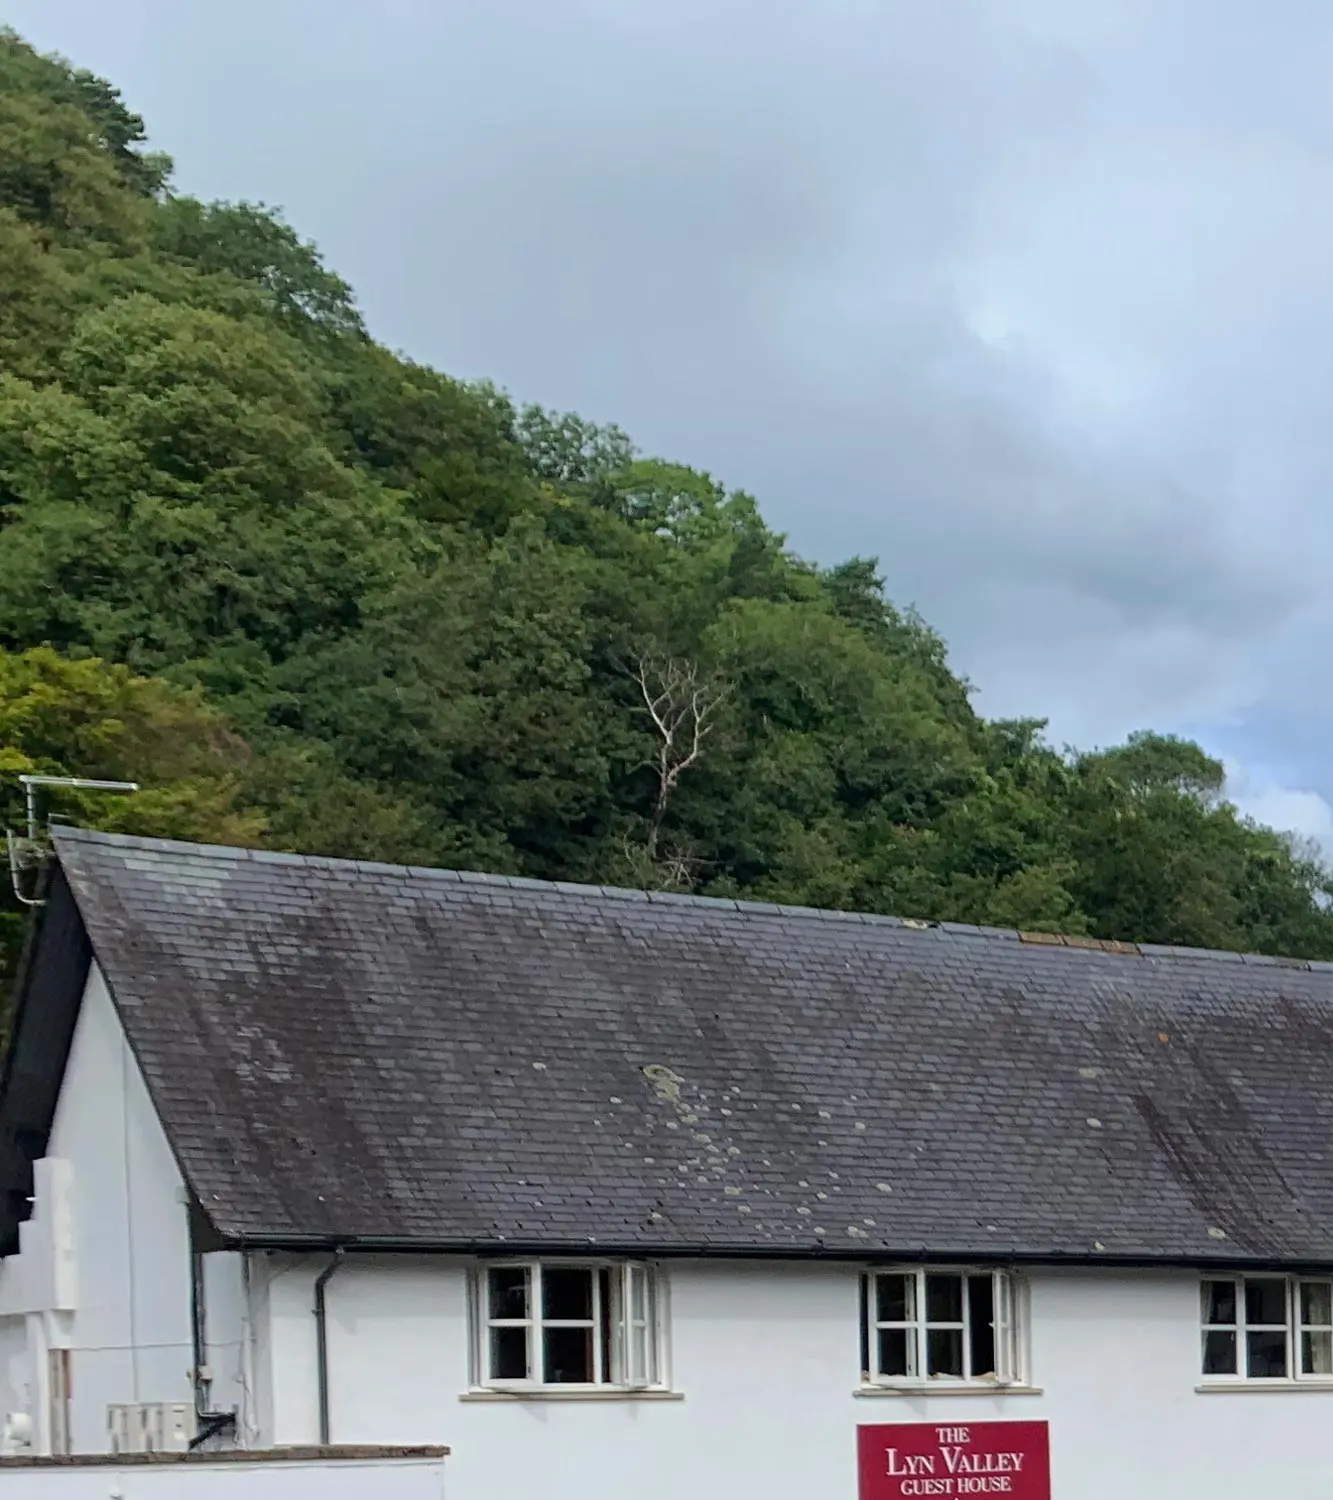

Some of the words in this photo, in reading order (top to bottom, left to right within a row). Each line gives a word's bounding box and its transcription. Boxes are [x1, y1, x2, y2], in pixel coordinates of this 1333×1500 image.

[935, 1427, 971, 1443] THE
[885, 1447, 935, 1476] LYN
[938, 1446, 1024, 1474] VALLEY
[900, 1478, 954, 1495] GUEST
[957, 1476, 1012, 1493] HOUSE
